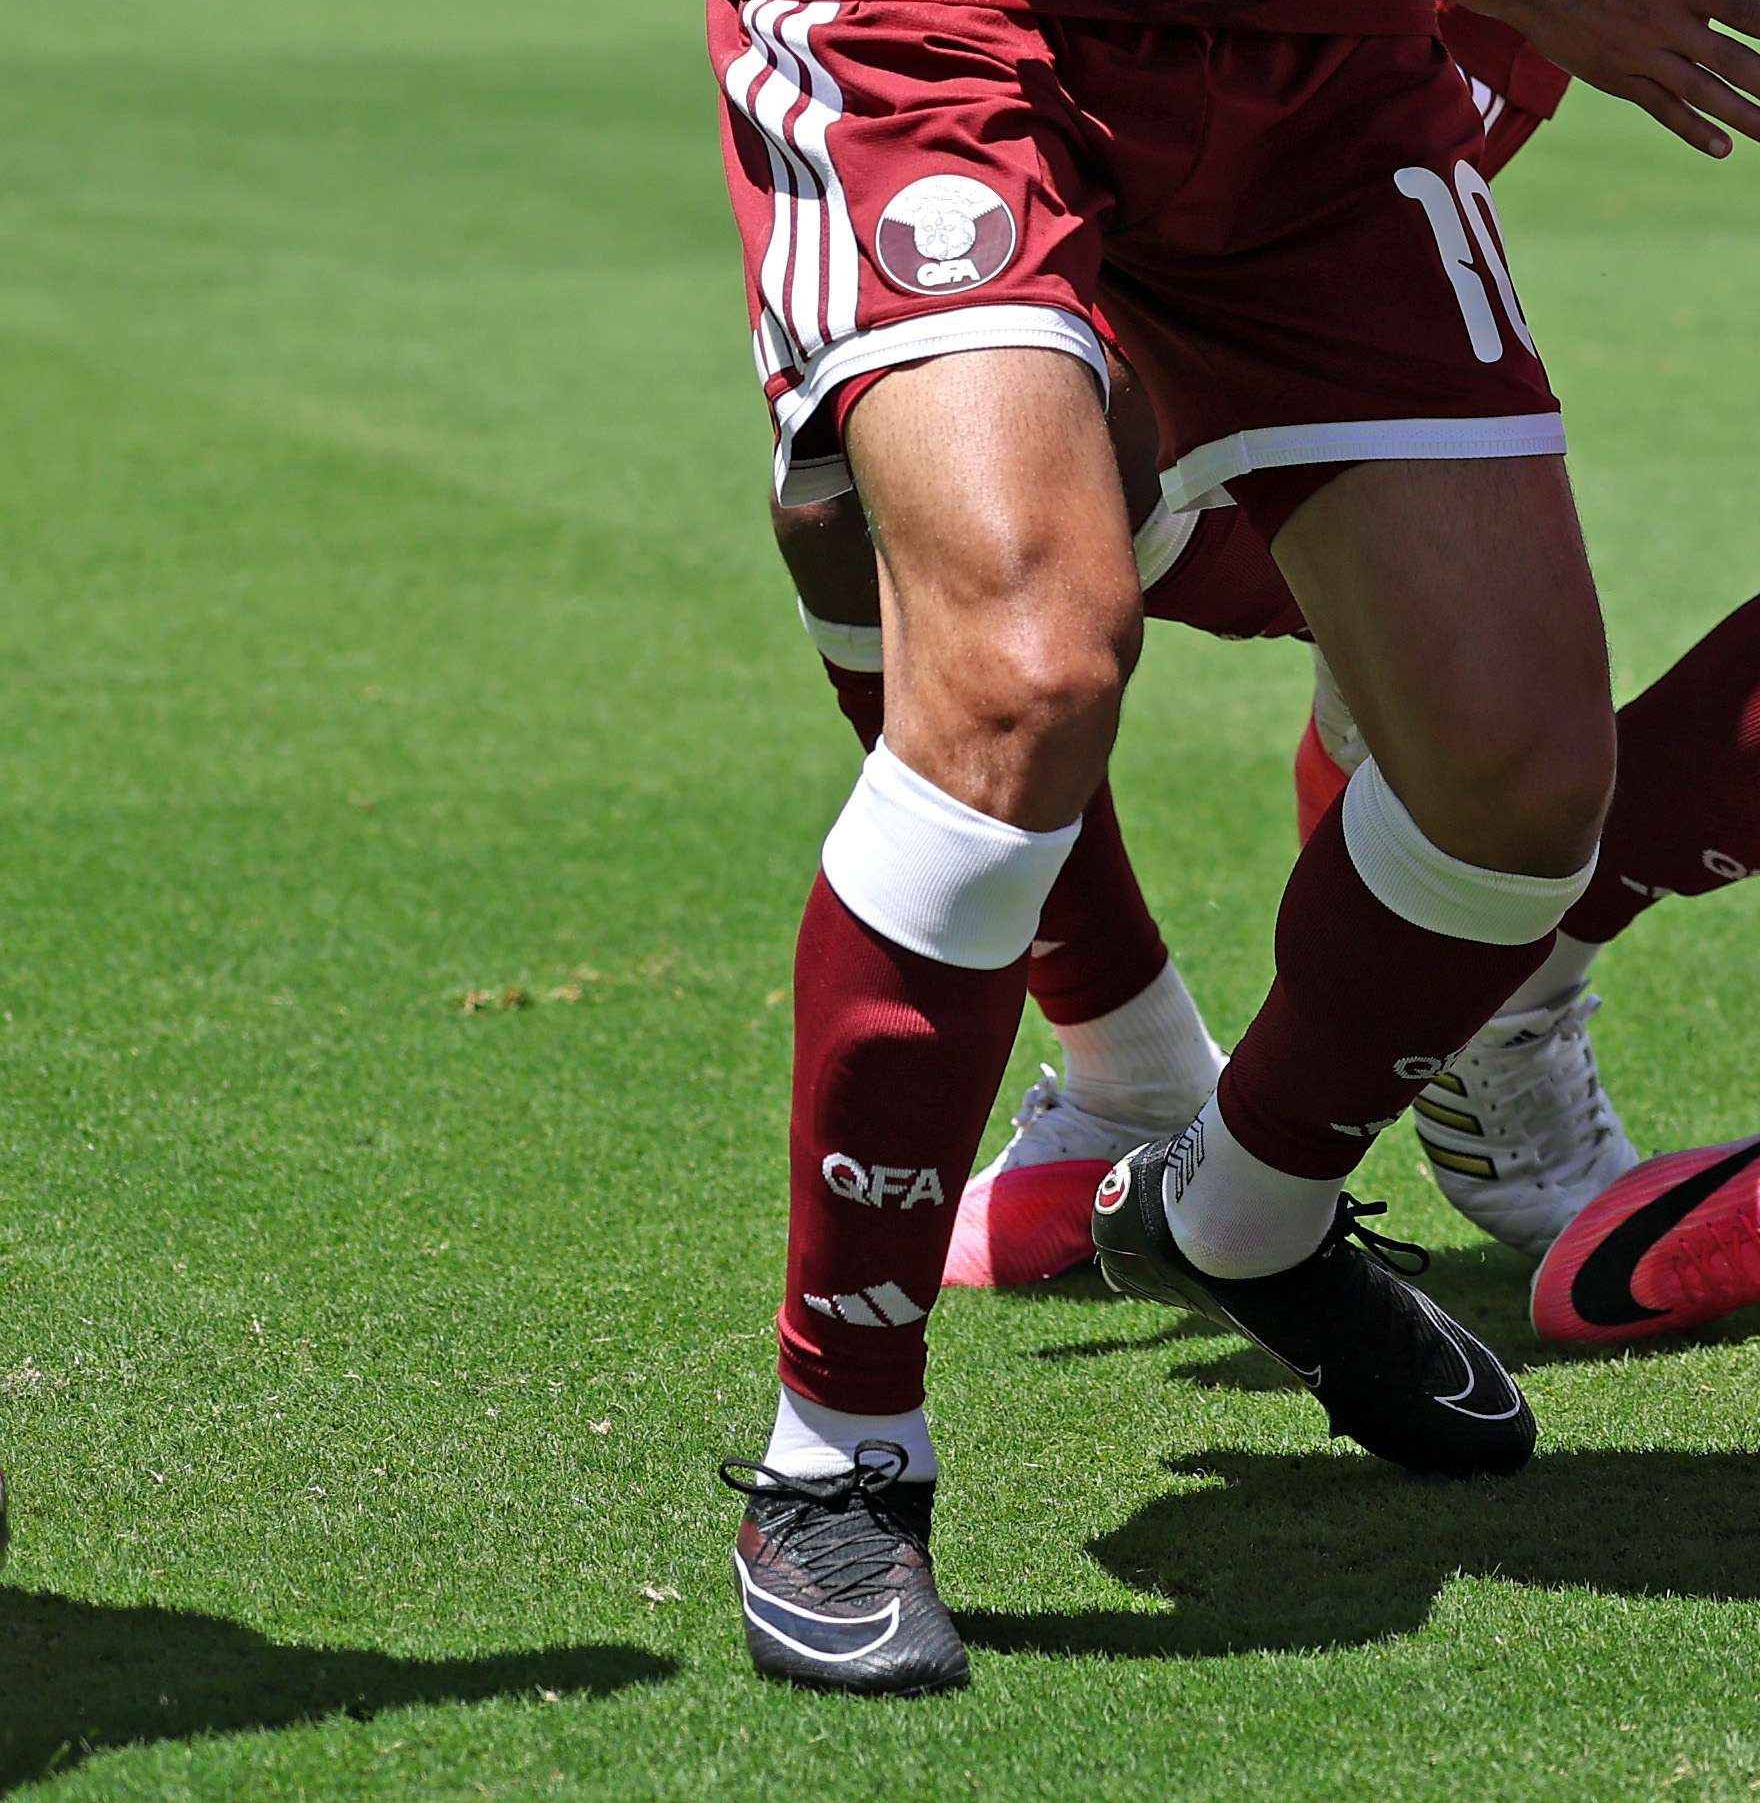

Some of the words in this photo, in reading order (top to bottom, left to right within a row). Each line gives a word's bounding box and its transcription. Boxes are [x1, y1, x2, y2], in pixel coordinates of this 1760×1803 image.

[917, 258, 981, 287] QFA
[1393, 159, 1538, 363] 10
[822, 1152, 945, 1210] QFA
